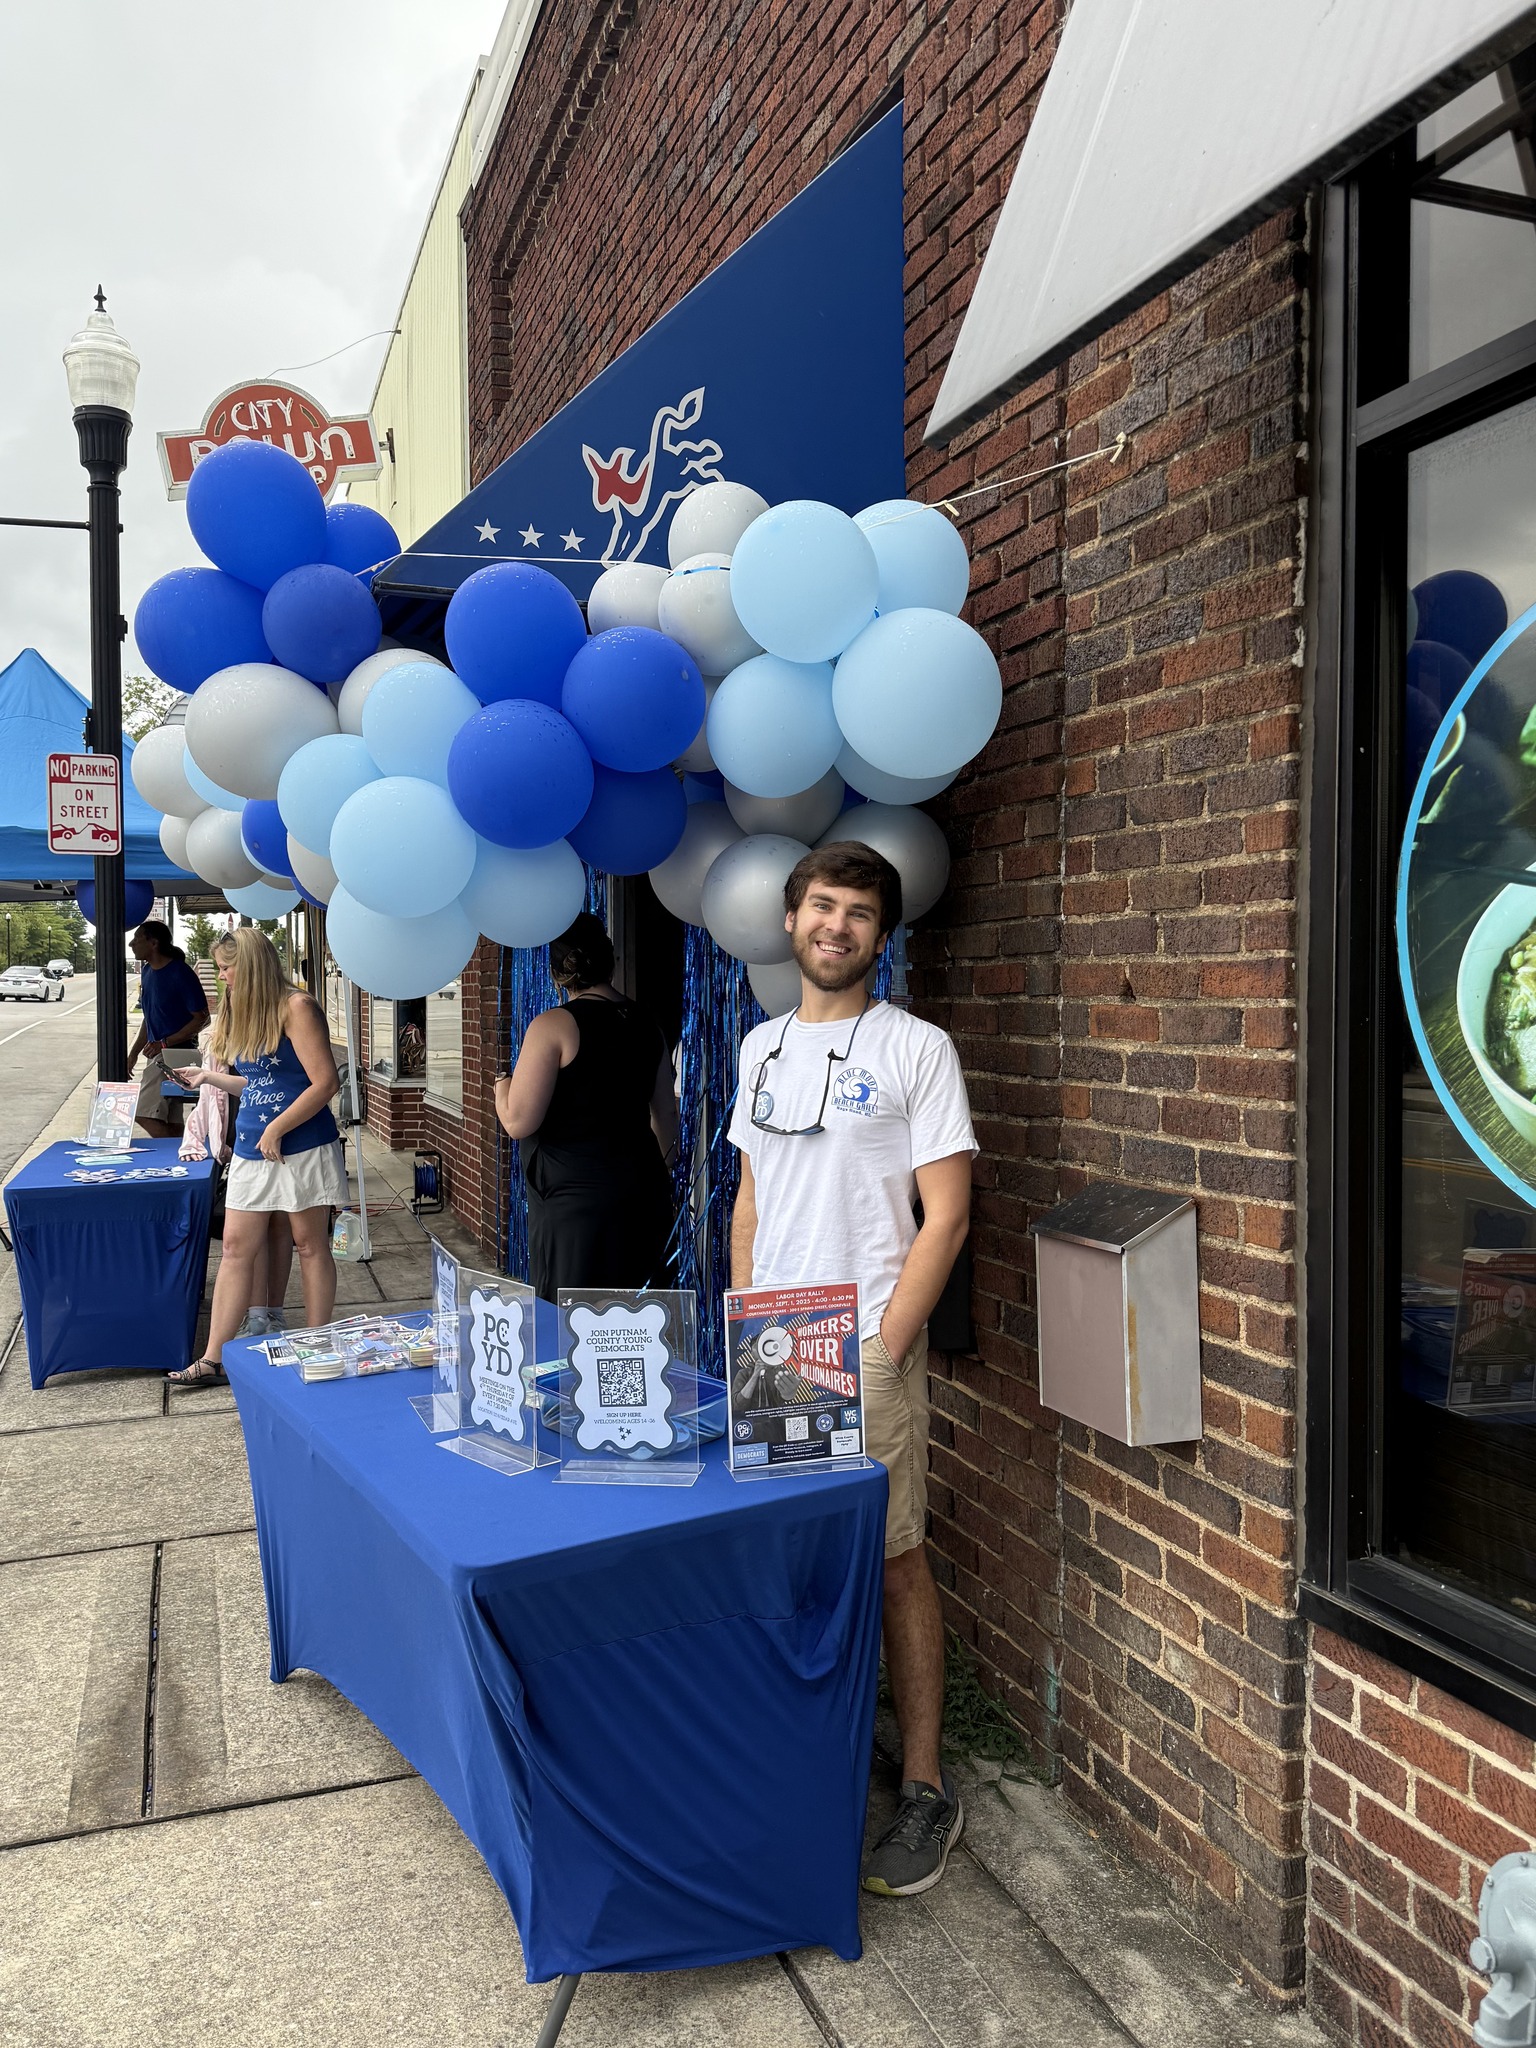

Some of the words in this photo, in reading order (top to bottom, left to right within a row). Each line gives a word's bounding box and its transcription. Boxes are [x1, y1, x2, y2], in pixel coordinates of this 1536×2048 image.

[231, 397, 293, 431] CITY
[50, 759, 70, 778] NO
[72, 763, 115, 778] PARKING
[75, 788, 94, 802] ON
[60, 805, 109, 819] STREET
[248, 1089, 286, 1107] Place
[483, 1312, 510, 1347] PC
[590, 1329, 609, 1337] JOIN
[610, 1328, 647, 1337] PUTNAM
[797, 1313, 854, 1337] WORKERS
[586, 1337, 621, 1345] COUNTY
[622, 1336, 653, 1344] YOUNG
[594, 1345, 645, 1353] DEMOCRATS
[481, 1341, 513, 1377] YD
[800, 1338, 840, 1366] OVER
[800, 1363, 855, 1397] BILLIONAIRES
[845, 1416, 857, 1424] YD
